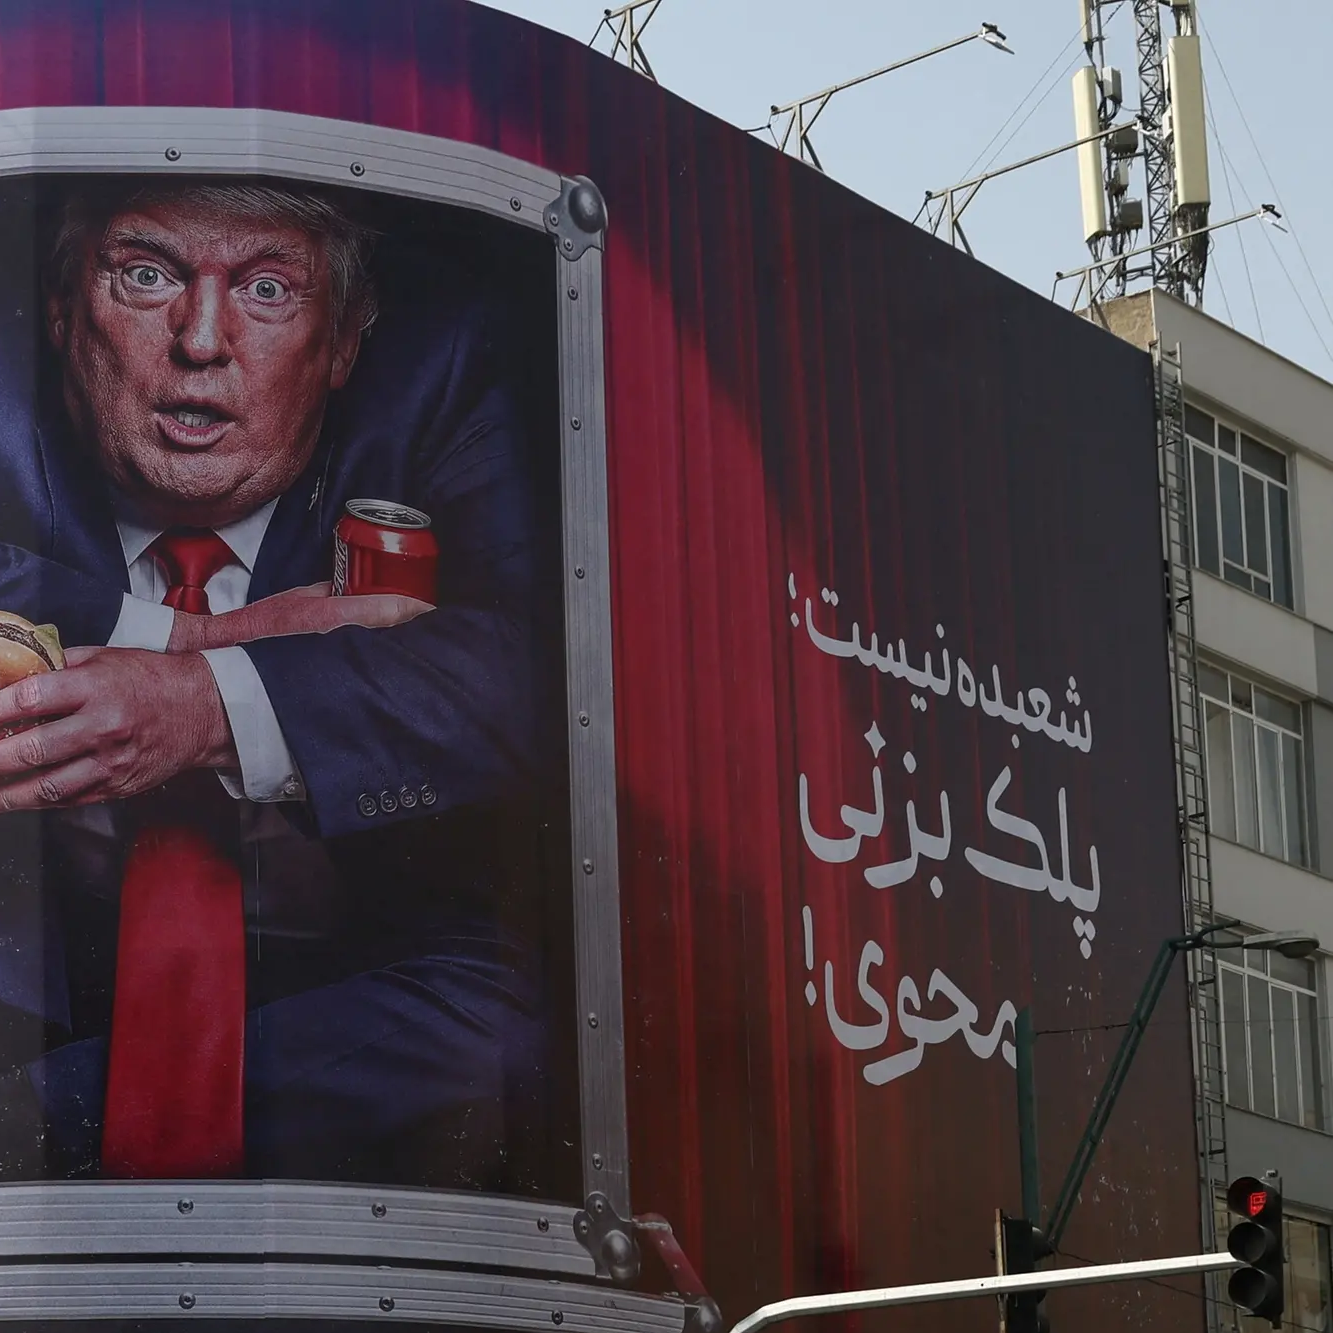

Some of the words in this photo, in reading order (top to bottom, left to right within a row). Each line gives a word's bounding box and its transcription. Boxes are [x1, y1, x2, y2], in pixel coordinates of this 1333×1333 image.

[957, 656, 1093, 753] شعبده
[798, 720, 952, 899] بزنی
[964, 765, 1102, 960] پلک
